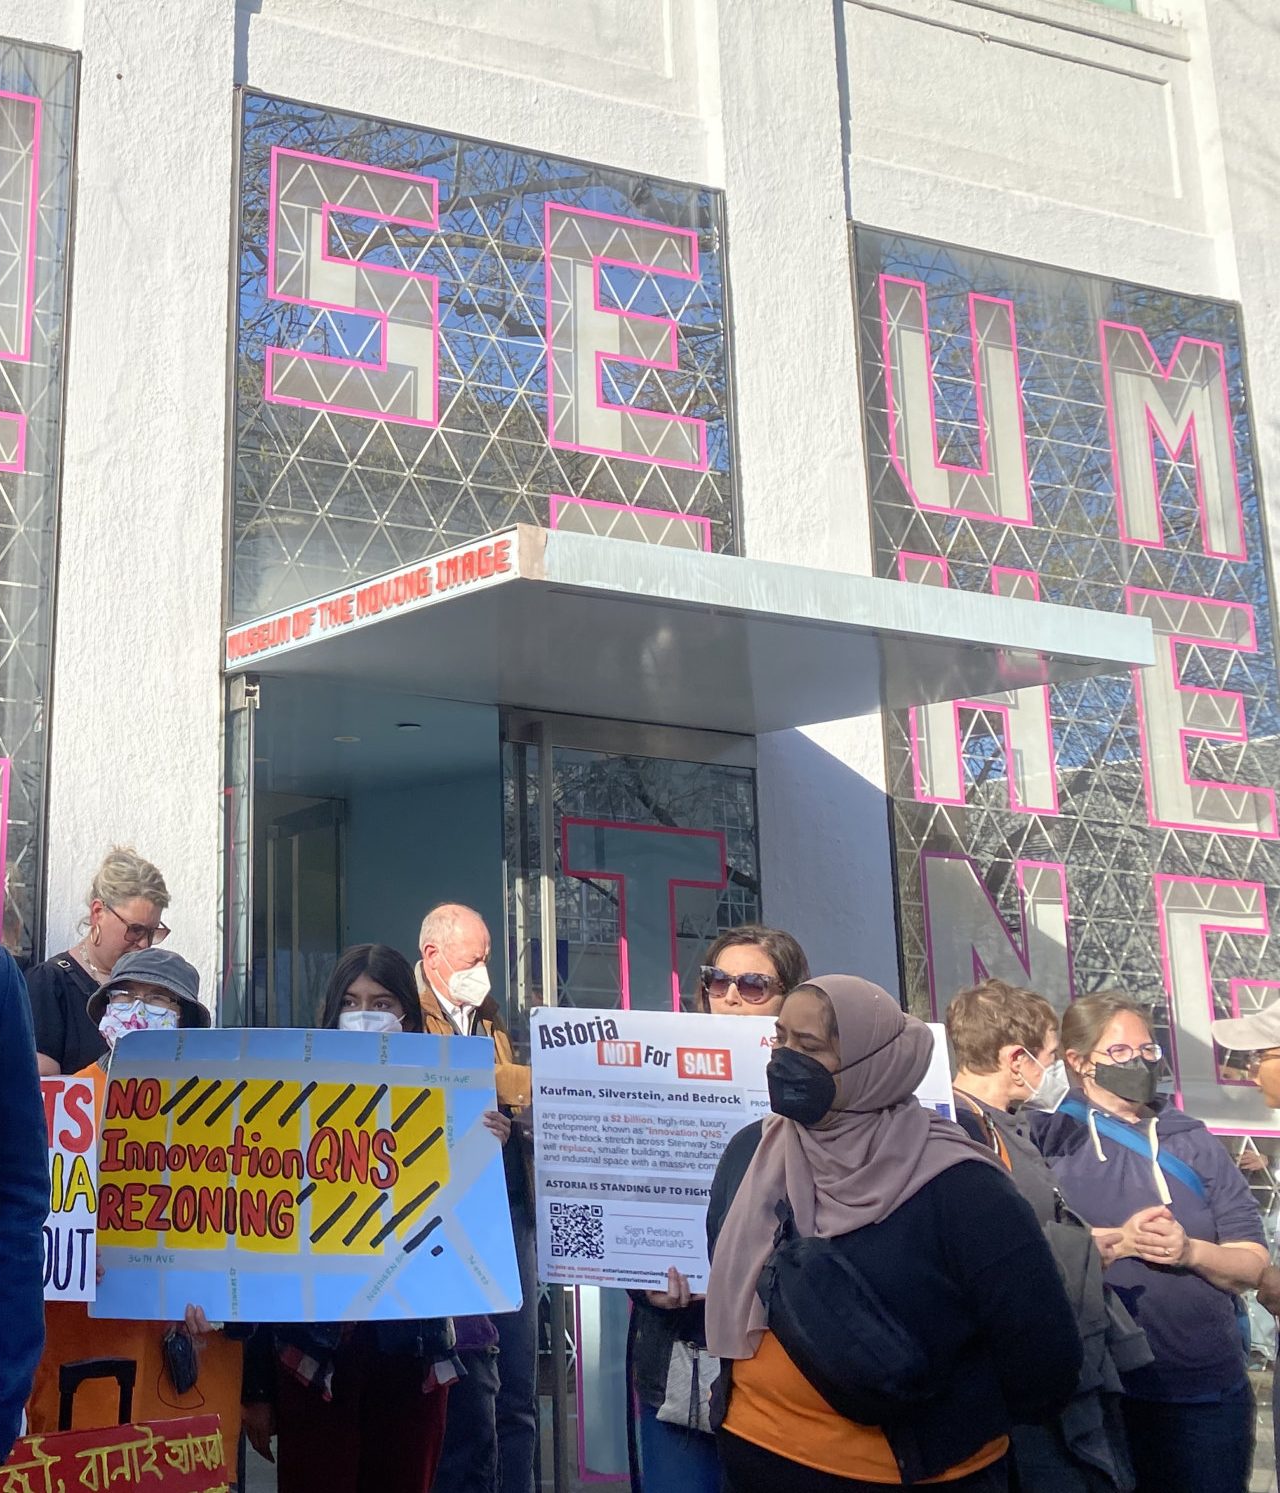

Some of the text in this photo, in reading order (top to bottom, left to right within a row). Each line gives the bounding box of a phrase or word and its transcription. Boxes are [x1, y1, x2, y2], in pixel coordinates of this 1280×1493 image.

[227, 539, 513, 661] MUSEUM OF THE MOVING IMAGE
[539, 1016, 725, 1076] Astoria NOT For SALE
[105, 1077, 162, 1121] NO
[540, 1085, 741, 1105] Kaufman, Silverstein, and Bedrock
[559, 1113, 601, 1123] proposing
[700, 1119, 727, 1129] luxury
[602, 1125, 631, 1133] known
[544, 1132, 559, 1140] The
[605, 1136, 634, 1144] stretch
[667, 1139, 708, 1149] Steinway
[306, 1126, 400, 1190] QNS
[598, 1146, 629, 1154] smaller
[562, 1155, 601, 1164] industrial
[603, 1157, 629, 1166] space
[631, 1159, 649, 1167] with
[659, 1161, 696, 1169] massive
[546, 1179, 587, 1190] ASTORIA
[589, 1182, 598, 1191] IS
[600, 1183, 651, 1194] STANDING
[653, 1186, 666, 1195] UP
[669, 1187, 682, 1196] TO
[97, 1182, 295, 1240] REZONING
[624, 1225, 684, 1237] Sign Petition
